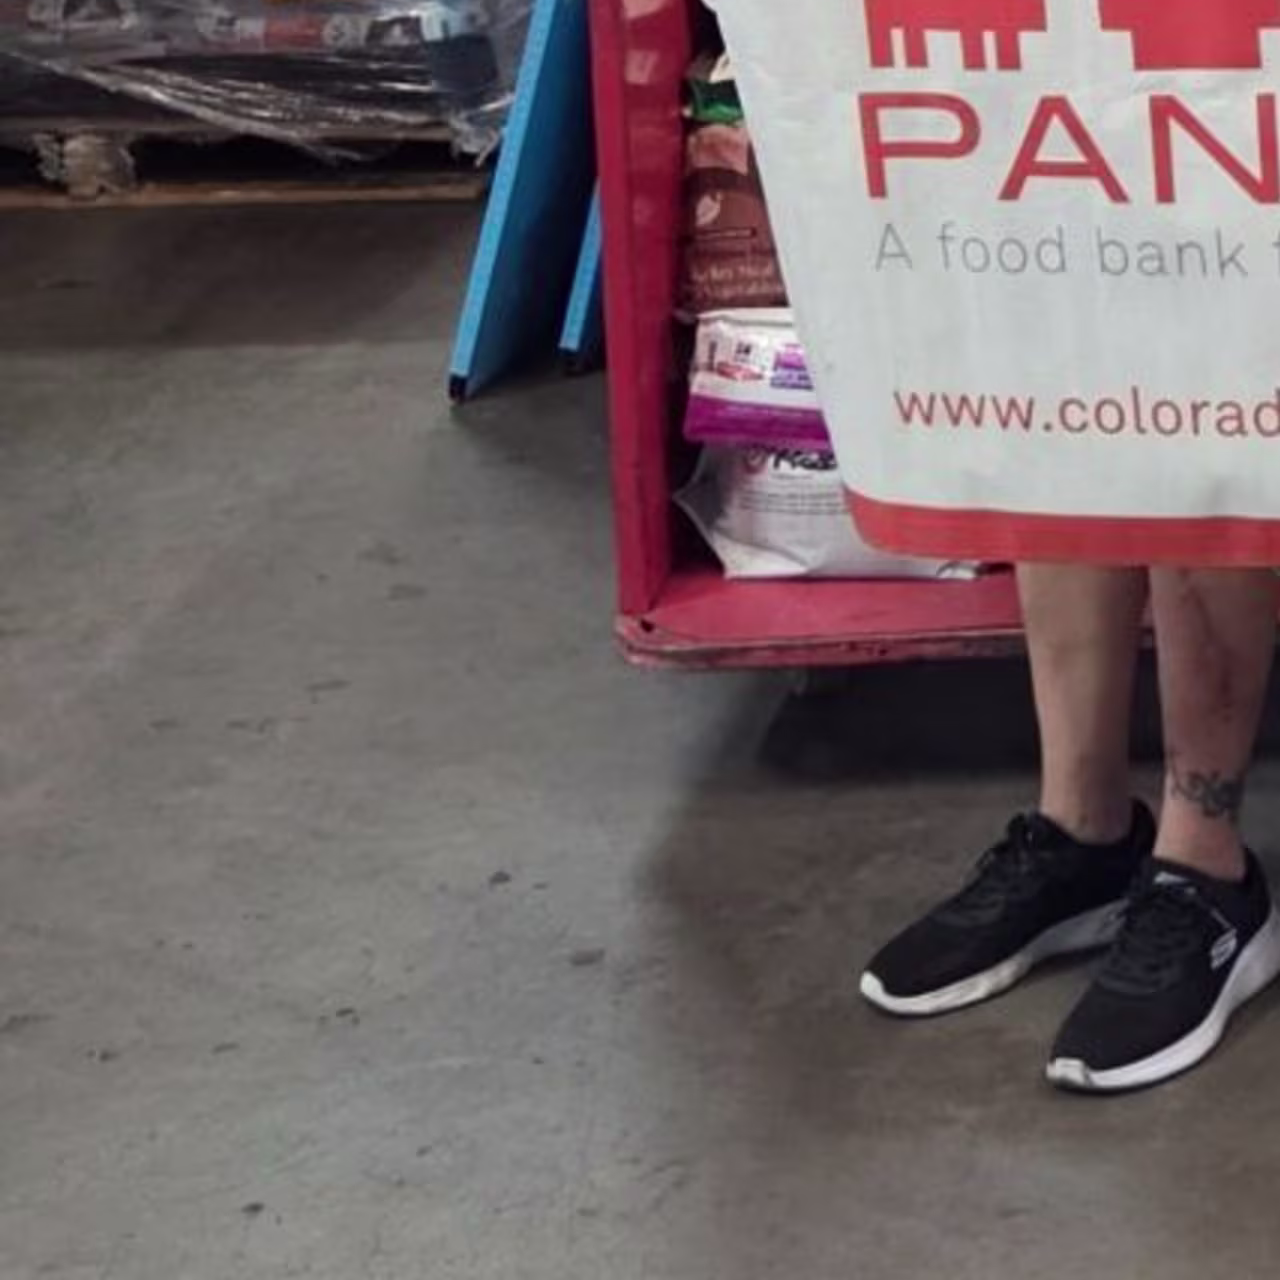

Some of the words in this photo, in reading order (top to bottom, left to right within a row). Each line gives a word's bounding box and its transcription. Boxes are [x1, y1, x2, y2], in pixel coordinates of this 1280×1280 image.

[873, 222, 913, 272] A
[937, 220, 1068, 276] food
[1098, 225, 1249, 280] bank
